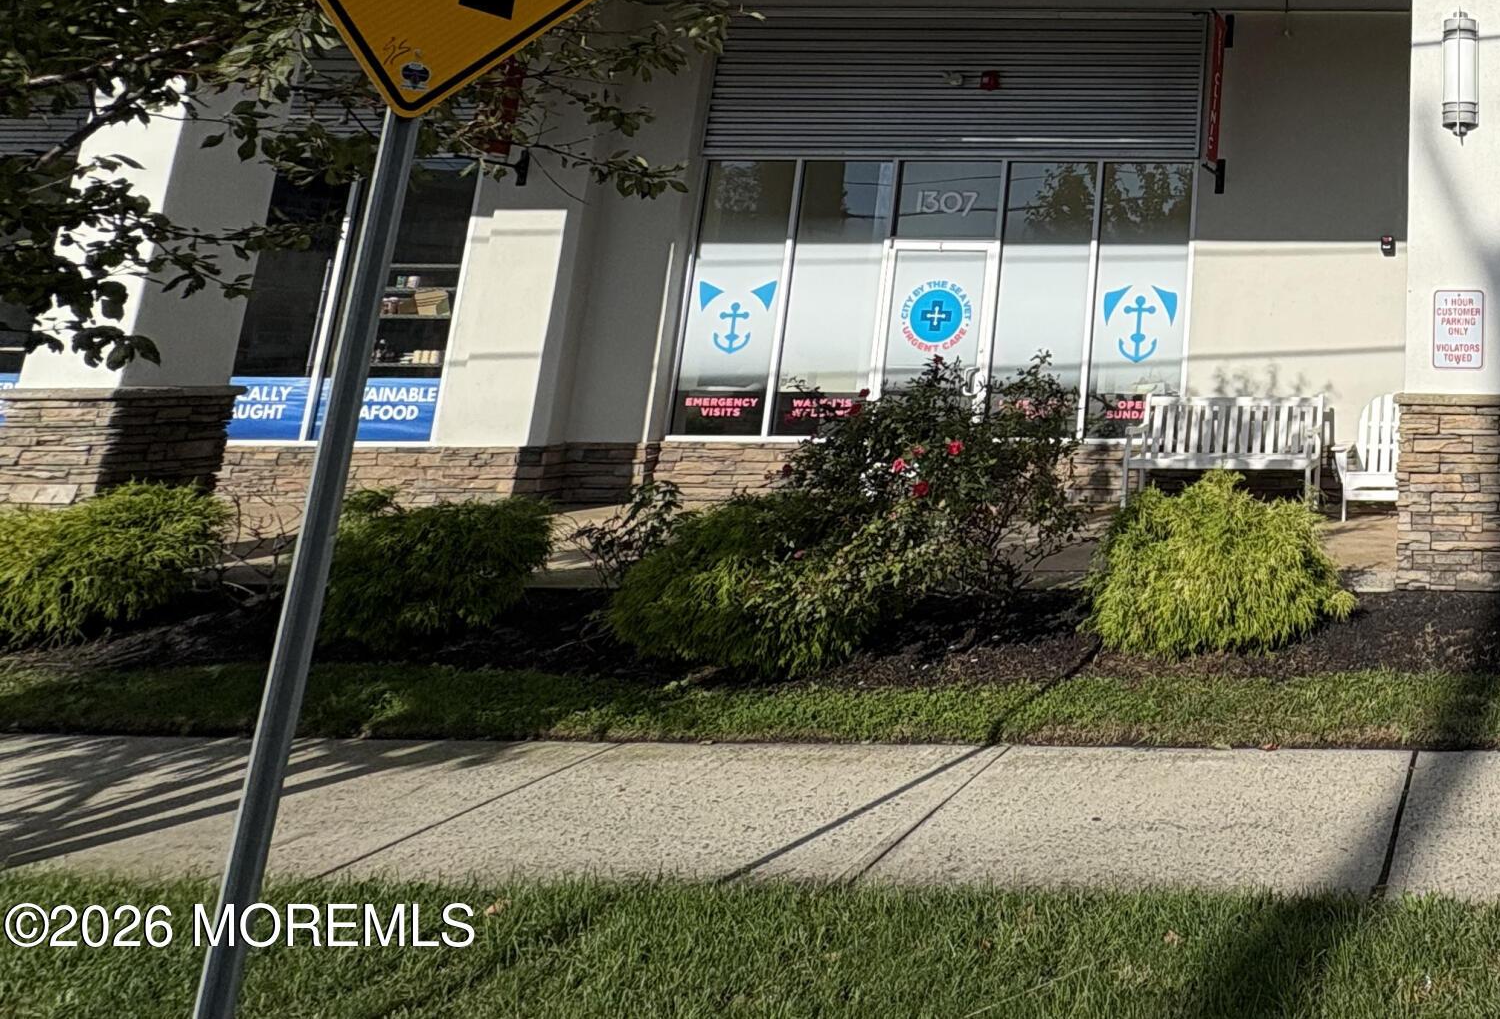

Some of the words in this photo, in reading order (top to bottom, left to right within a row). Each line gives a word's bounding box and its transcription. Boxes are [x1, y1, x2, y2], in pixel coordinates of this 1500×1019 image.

[1207, 72, 1221, 149] CLINIC
[916, 191, 978, 217] 1307
[901, 296, 914, 319] CITY
[912, 284, 925, 297] BY
[926, 280, 949, 289] THE
[950, 283, 967, 301] SEA
[1451, 298, 1473, 306] HOUR
[1436, 308, 1480, 316] CUSTOMER
[1441, 317, 1476, 325] PARKING
[1448, 327, 1468, 335] ONLY
[902, 326, 939, 353] URGENT
[942, 328, 967, 351] CARE
[1436, 344, 1480, 352] VIOLATORS
[1444, 353, 1472, 362] TOWED
[685, 397, 759, 407] EMERGENCY
[232, 404, 287, 419] AUGHT
[359, 405, 419, 420] AFOOD
[700, 407, 741, 417] VISITS
